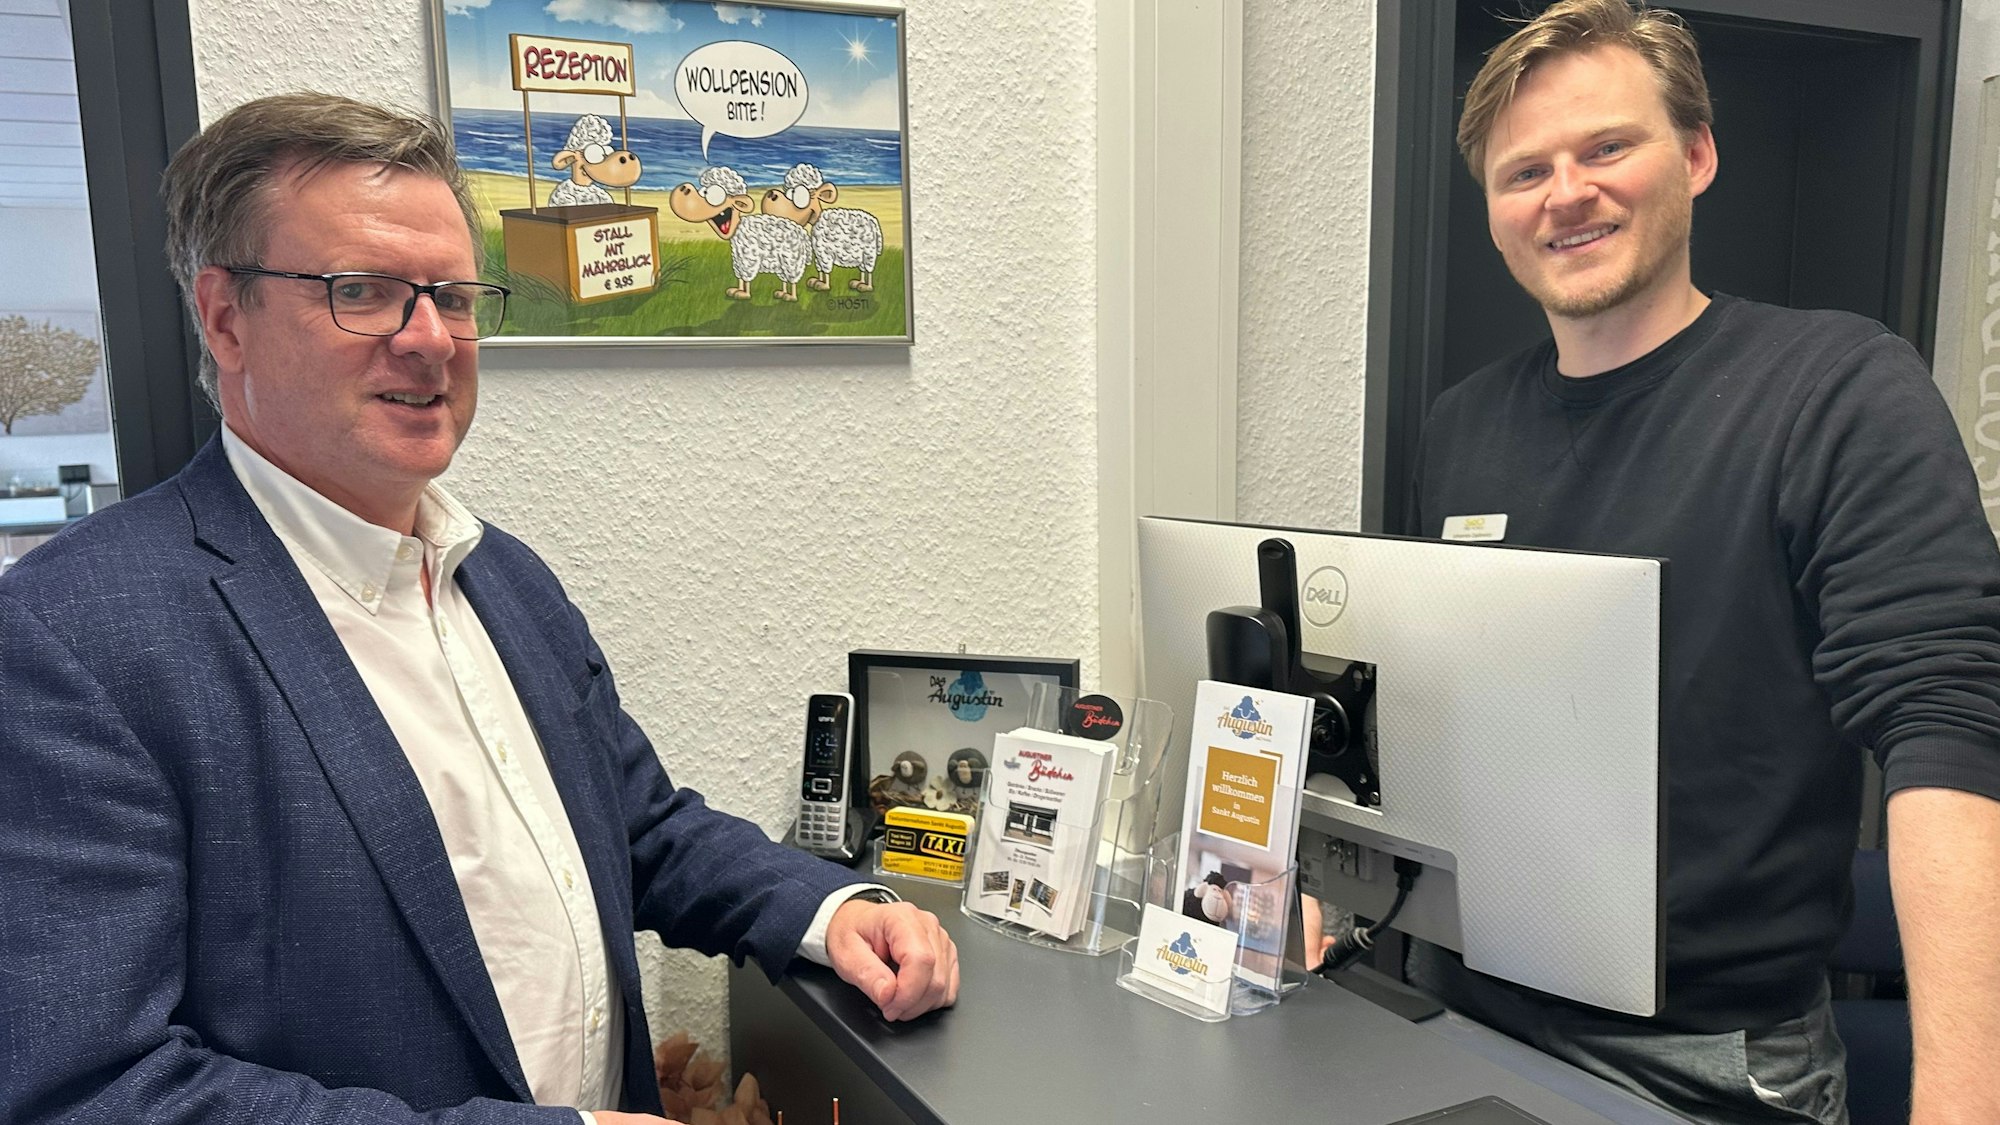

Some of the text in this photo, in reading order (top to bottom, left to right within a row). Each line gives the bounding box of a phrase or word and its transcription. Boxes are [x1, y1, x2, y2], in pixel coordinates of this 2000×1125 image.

[524, 45, 627, 83] REZEPTION
[685, 66, 797, 98] WOLLPENSION
[727, 101, 757, 121] BITTE
[594, 226, 633, 243] STALL
[604, 242, 625, 257] MIT
[582, 253, 651, 278] MÄHRBLICK
[614, 275, 633, 289] 9,95
[1306, 587, 1342, 606] DELL
[928, 688, 1004, 711] Augustin
[1217, 711, 1273, 737] Augustin
[1028, 759, 1074, 782] Büdchen
[1222, 770, 1258, 788] Herzlich
[1212, 783, 1265, 804] willkommen
[1211, 806, 1260, 825] Sankt Augustin
[1233, 802, 1241, 810] in
[927, 836, 964, 855] TAXI
[1156, 944, 1208, 976] Augustin
